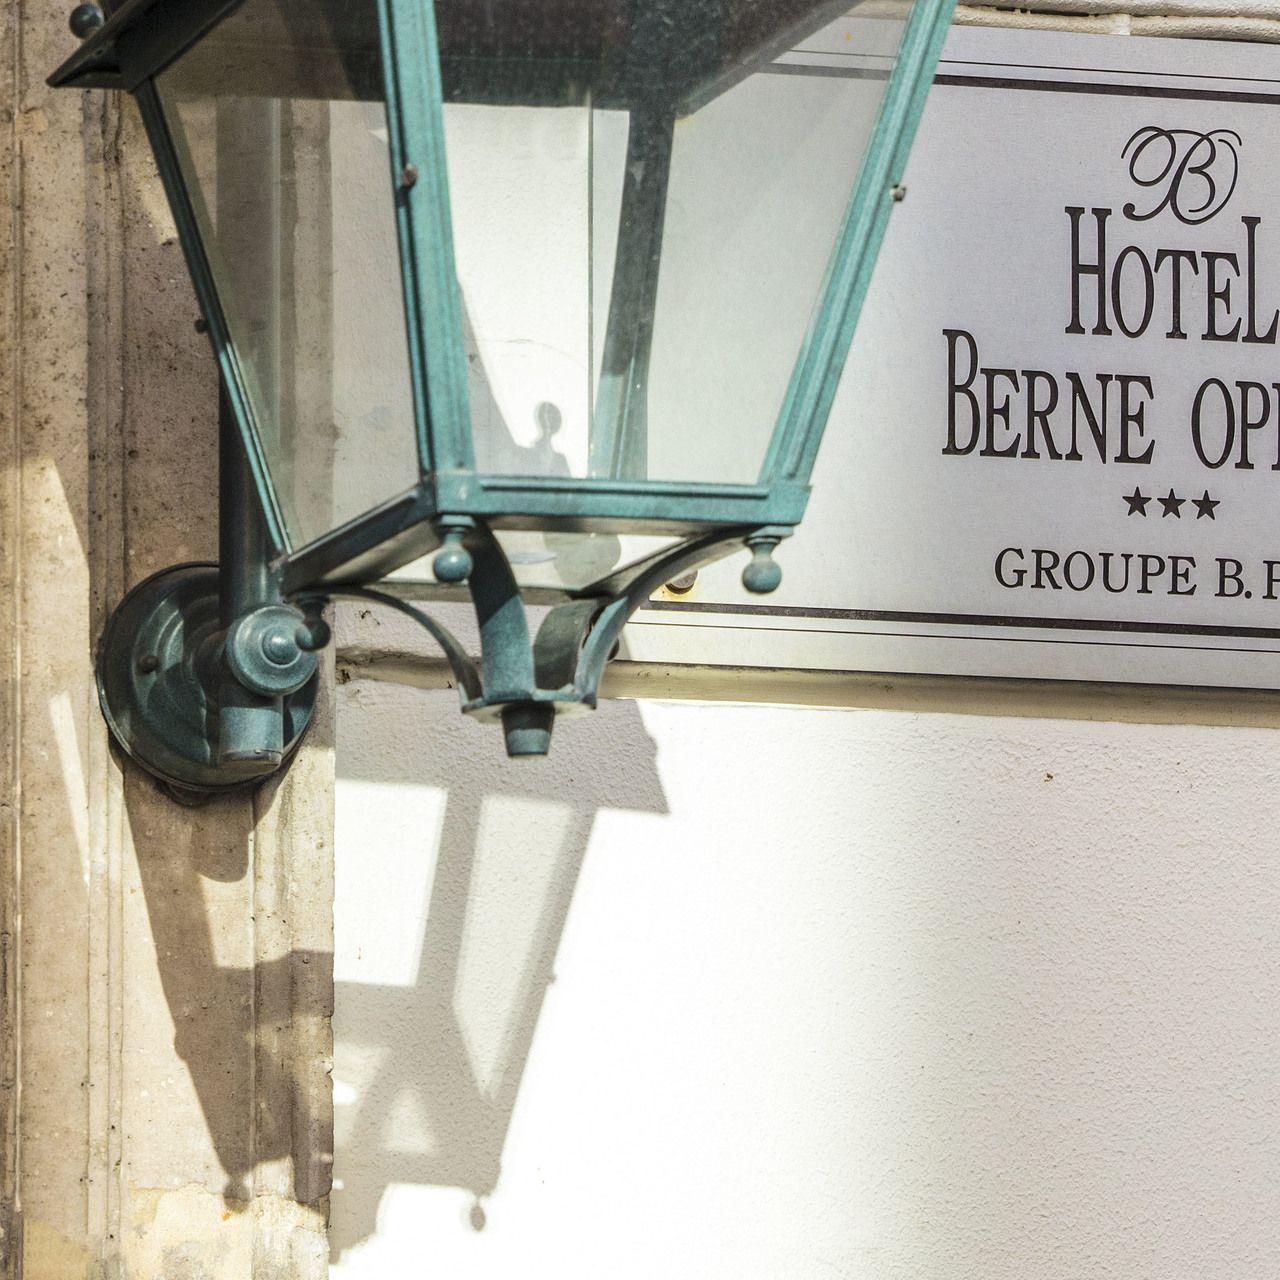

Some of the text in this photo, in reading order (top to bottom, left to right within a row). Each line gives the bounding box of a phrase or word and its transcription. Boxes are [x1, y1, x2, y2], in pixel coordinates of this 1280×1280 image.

[1064, 205, 1280, 345] HOTEL
[941, 328, 1156, 465] BERNE
[994, 547, 1198, 596] GROUPE
